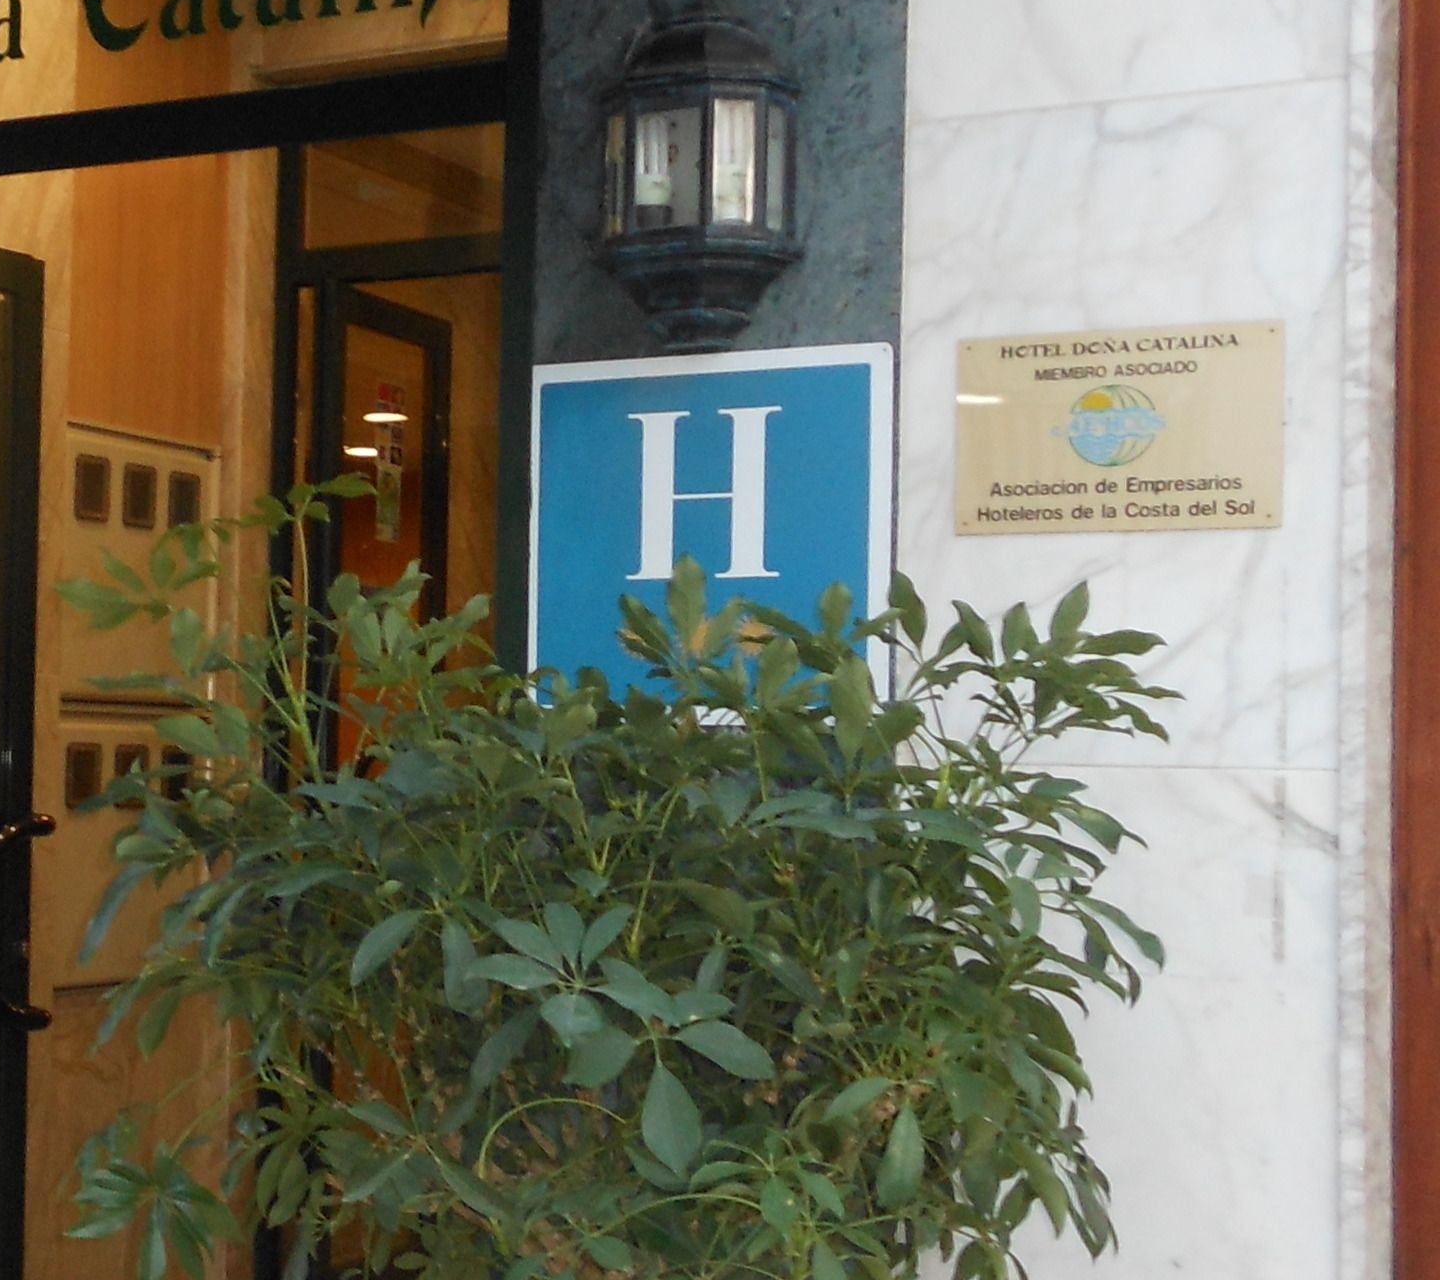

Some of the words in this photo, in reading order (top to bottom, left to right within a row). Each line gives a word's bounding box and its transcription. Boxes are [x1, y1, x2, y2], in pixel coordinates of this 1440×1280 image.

[1000, 342, 1067, 360] HOTEL
[1072, 337, 1130, 356] DOÑA
[1136, 333, 1240, 352] CATALINA
[1034, 365, 1107, 382] MIEMBRO
[1114, 360, 1198, 378] ASOCIADO
[626, 405, 782, 580] H
[990, 480, 1088, 497] Asociacion
[1095, 477, 1118, 494] de
[1126, 475, 1242, 495] Empresarios
[977, 505, 1064, 522] Hoteleros
[1071, 503, 1095, 520] de
[1101, 503, 1118, 519] la
[1125, 502, 1180, 518] Costa
[1188, 500, 1217, 517] del
[1225, 498, 1255, 516] Sol
